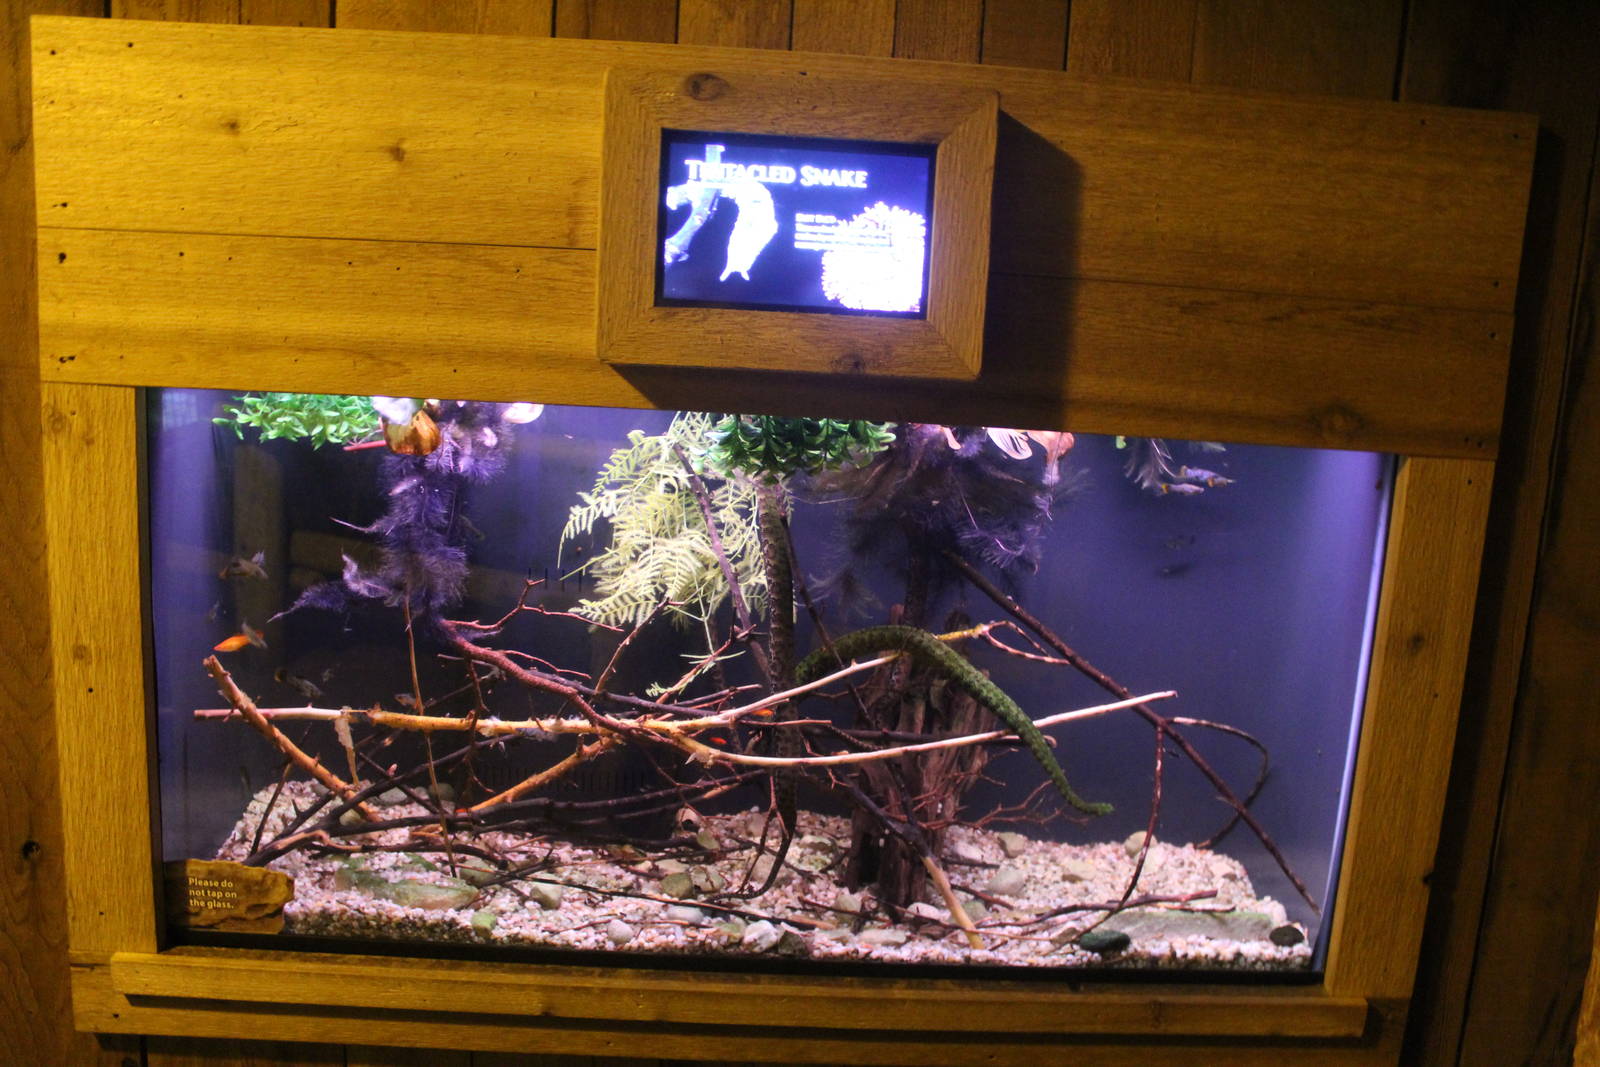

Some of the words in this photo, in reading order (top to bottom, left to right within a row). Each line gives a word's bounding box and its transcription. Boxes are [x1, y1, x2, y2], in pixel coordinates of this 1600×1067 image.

[684, 159, 797, 184] TTACLED
[800, 165, 868, 188] SNAKE
[188, 877, 219, 887] Please
[221, 880, 233, 888] do
[207, 890, 223, 899] tap
[207, 900, 234, 909] glass.
